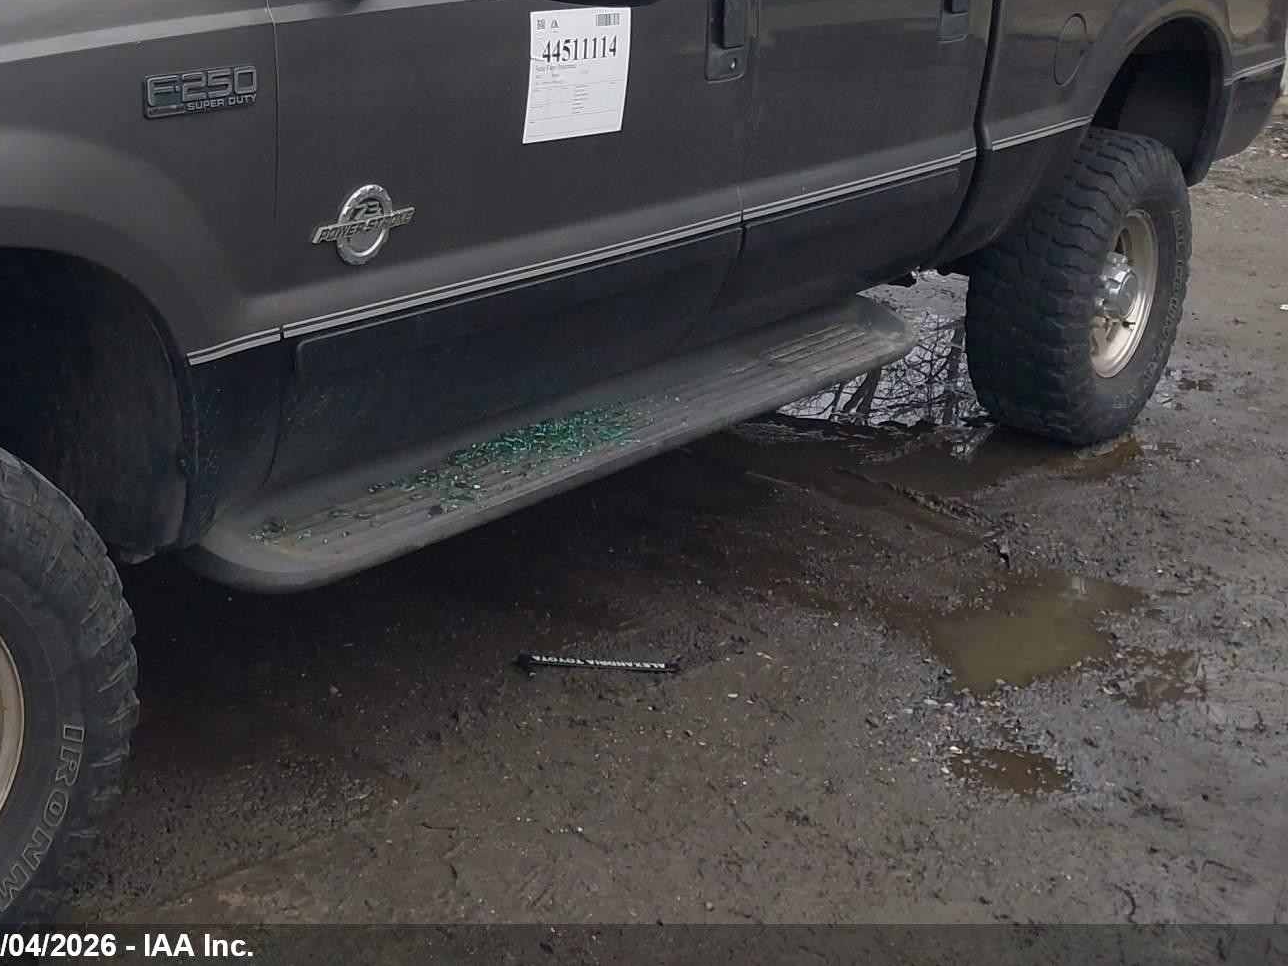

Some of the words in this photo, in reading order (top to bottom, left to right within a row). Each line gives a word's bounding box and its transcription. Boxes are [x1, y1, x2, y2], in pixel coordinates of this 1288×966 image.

[542, 35, 617, 63] 44511114
[187, 98, 225, 111] SUPER
[228, 94, 257, 106] DUTY
[532, 654, 585, 665] TOYOTA
[585, 659, 665, 669] ALEXANDRIA
